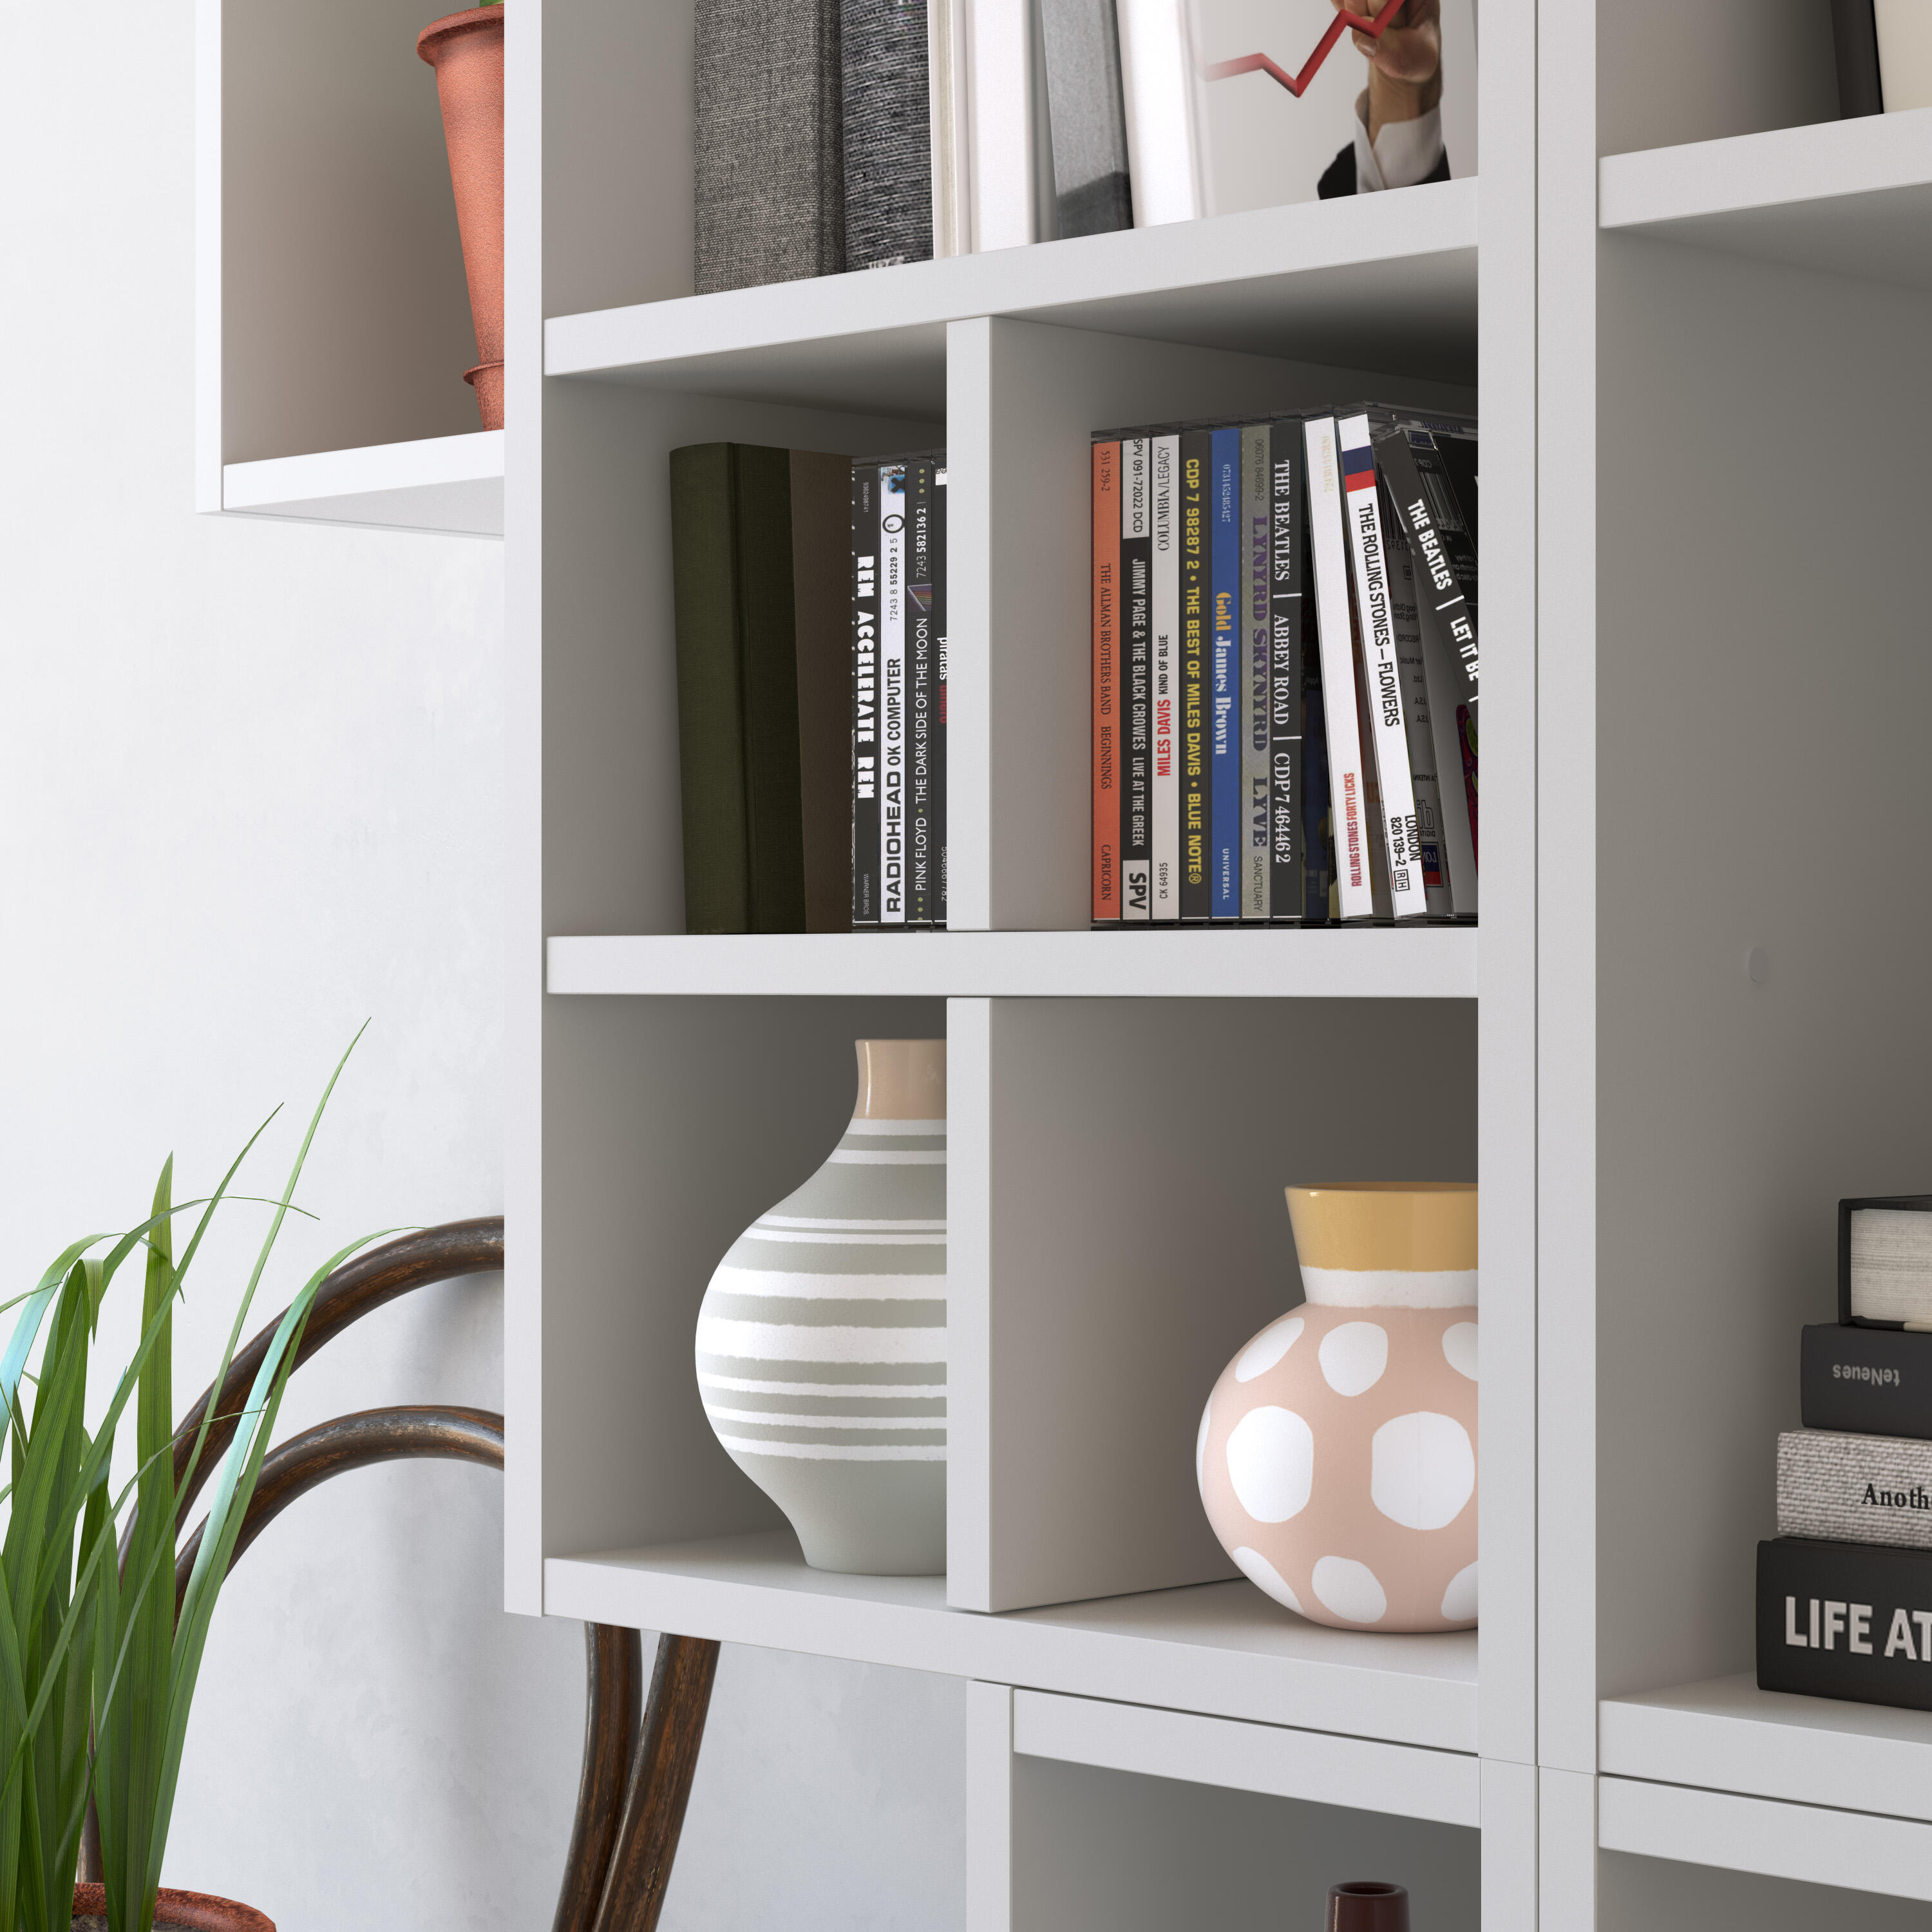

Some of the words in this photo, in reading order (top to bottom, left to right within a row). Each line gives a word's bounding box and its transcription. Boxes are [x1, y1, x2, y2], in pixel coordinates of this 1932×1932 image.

[1101, 450, 1110, 466] 531
[1133, 439, 1143, 457] SPV
[1101, 468, 1110, 491] 259-2
[1133, 459, 1143, 509] 091-72022
[1186, 459, 1200, 489] CDP
[1274, 459, 1290, 497] THE
[1158, 446, 1170, 551] COLUMBIA/LEGACY
[1186, 493, 1200, 502] 7
[1408, 498, 1431, 531] THE
[1133, 511, 1143, 533] DCD
[1186, 507, 1200, 554] 98287
[1359, 503, 1376, 533] THE
[1274, 501, 1290, 582] BEATLES
[857, 556, 875, 598] REM
[889, 556, 898, 585] 55229
[916, 555, 927, 578] 7243
[1101, 563, 1112, 584] THE
[1132, 558, 1146, 595] JIMMY
[1186, 560, 1200, 569] 2
[1253, 517, 1268, 621] LYNYRD
[1362, 533, 1384, 591] ROLLING
[1418, 529, 1453, 591] BEATLES
[889, 598, 898, 621] 7243
[1101, 587, 1112, 627] ALLMAN
[1132, 600, 1146, 627] PAGE
[1186, 587, 1200, 614] THE
[1215, 592, 1232, 631] Gold
[1132, 630, 1146, 639] &
[1369, 592, 1390, 647] STONES
[1450, 616, 1473, 643] LET
[916, 618, 928, 658] MOON
[1132, 642, 1146, 662] THE
[1159, 634, 1168, 658] BLUE
[1186, 620, 1200, 656] BEST
[1273, 614, 1289, 672] ABBEY
[1459, 643, 1478, 659] IT
[938, 636, 947, 680] piratas
[1101, 629, 1112, 683] BROTHERS
[1159, 660, 1169, 674] OF
[1187, 660, 1200, 679] OF
[1215, 636, 1232, 692] James
[1465, 659, 1478, 681] BE
[857, 611, 875, 743] ACCELERATE
[916, 663, 927, 687] THE
[1132, 665, 1146, 700] BLACK
[1159, 676, 1169, 694] KIND
[1253, 629, 1268, 752] SKYNYRD
[886, 658, 902, 741] COMPUTER
[916, 696, 927, 708] OF
[1100, 685, 1112, 715] BAND
[1187, 684, 1201, 728] MILES
[1273, 676, 1289, 725] ROAD
[1378, 661, 1401, 727] FLOWERS
[915, 710, 927, 739] SIDE
[1132, 703, 1146, 750] CROWES
[1157, 699, 1171, 735] DAVIS
[1215, 697, 1232, 755] Brown
[886, 744, 902, 766] OK
[915, 741, 927, 778] DARK
[1100, 726, 1112, 790] BEGINNINGS
[1132, 757, 1145, 777] LIVE
[1157, 737, 1171, 777] MILES
[1187, 733, 1201, 777] DAVIS
[1274, 752, 1290, 791] CDP
[857, 756, 875, 799] REM
[915, 779, 927, 804] THE
[1132, 778, 1145, 791] AT
[1343, 772, 1356, 796] LICKS
[1132, 793, 1144, 812] THE
[1188, 793, 1201, 830] BLUE
[1253, 777, 1268, 848] LYVE
[1274, 795, 1291, 803] 7
[1345, 797, 1358, 820] FORTY
[886, 772, 902, 913] RADIOHEAD
[915, 817, 927, 858] FLOYD
[1132, 814, 1144, 847] GREEK
[1274, 806, 1291, 851] 46446
[1347, 821, 1360, 853] STONES
[1390, 816, 1403, 835] 820
[1405, 815, 1421, 862] LONDON
[1100, 844, 1112, 900] CAPRICORN
[1159, 862, 1168, 886] 64935
[1274, 853, 1291, 863] 2
[1349, 853, 1363, 887] ROLLING
[915, 862, 927, 891] PINK
[1128, 872, 1147, 910] SPV
[1159, 887, 1168, 899] CK
[1253, 856, 1264, 912] SANCTUARY
[1832, 1363, 1900, 1387] teNeues
[1861, 1482, 1932, 1511] Anoth
[1785, 1596, 1873, 1656] LIFE
[1884, 1607, 1932, 1663] AT
